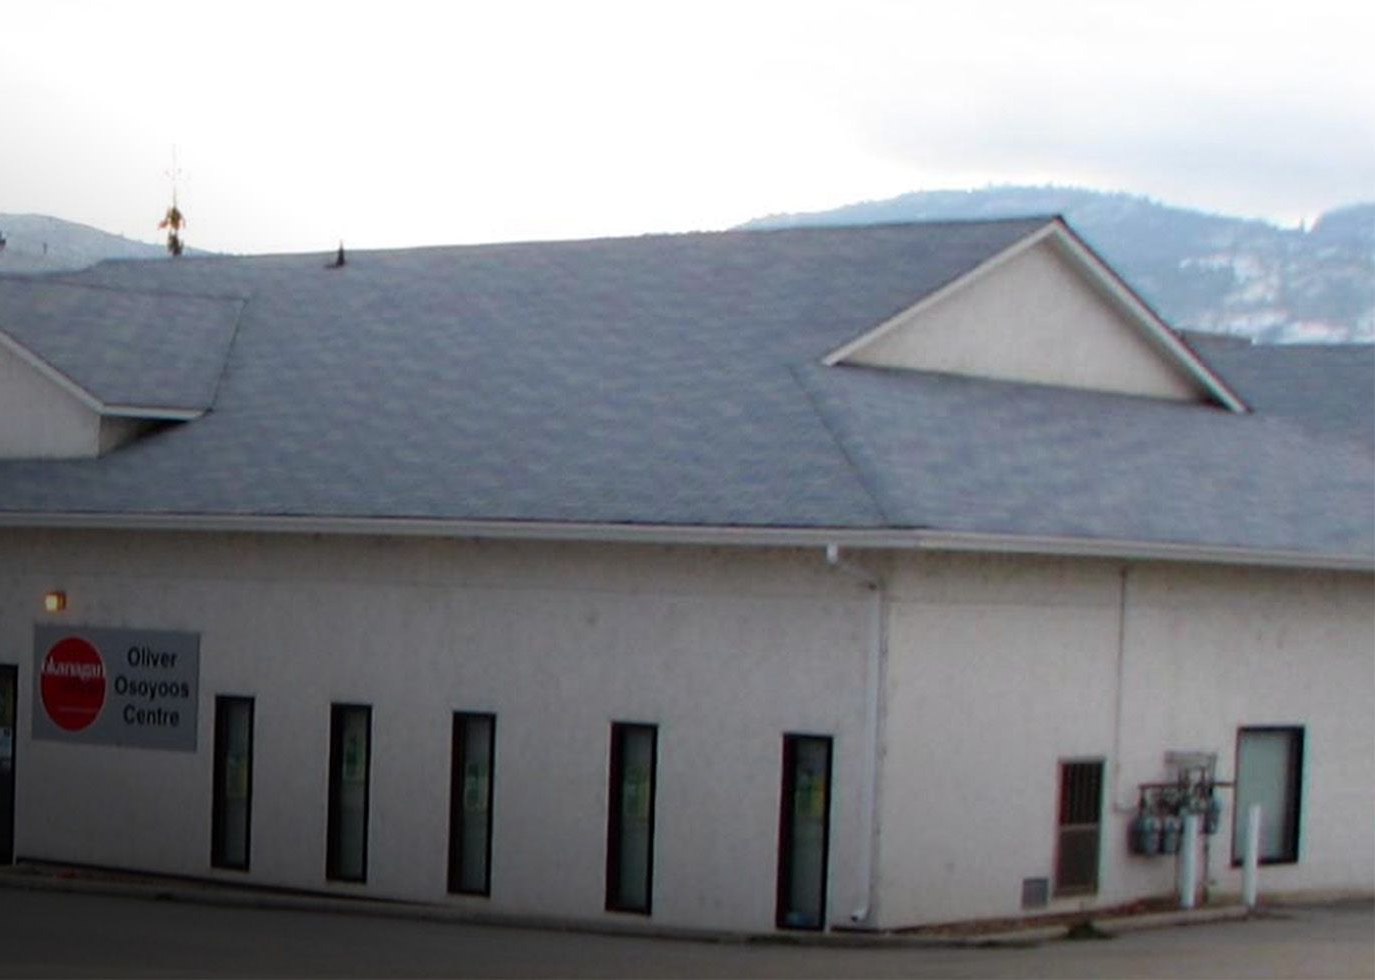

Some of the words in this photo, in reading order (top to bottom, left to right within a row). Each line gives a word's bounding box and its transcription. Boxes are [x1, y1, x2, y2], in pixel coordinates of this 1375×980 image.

[127, 646, 178, 668] Oliver
[114, 675, 189, 700] Osoyoos
[123, 704, 180, 727] Centre
